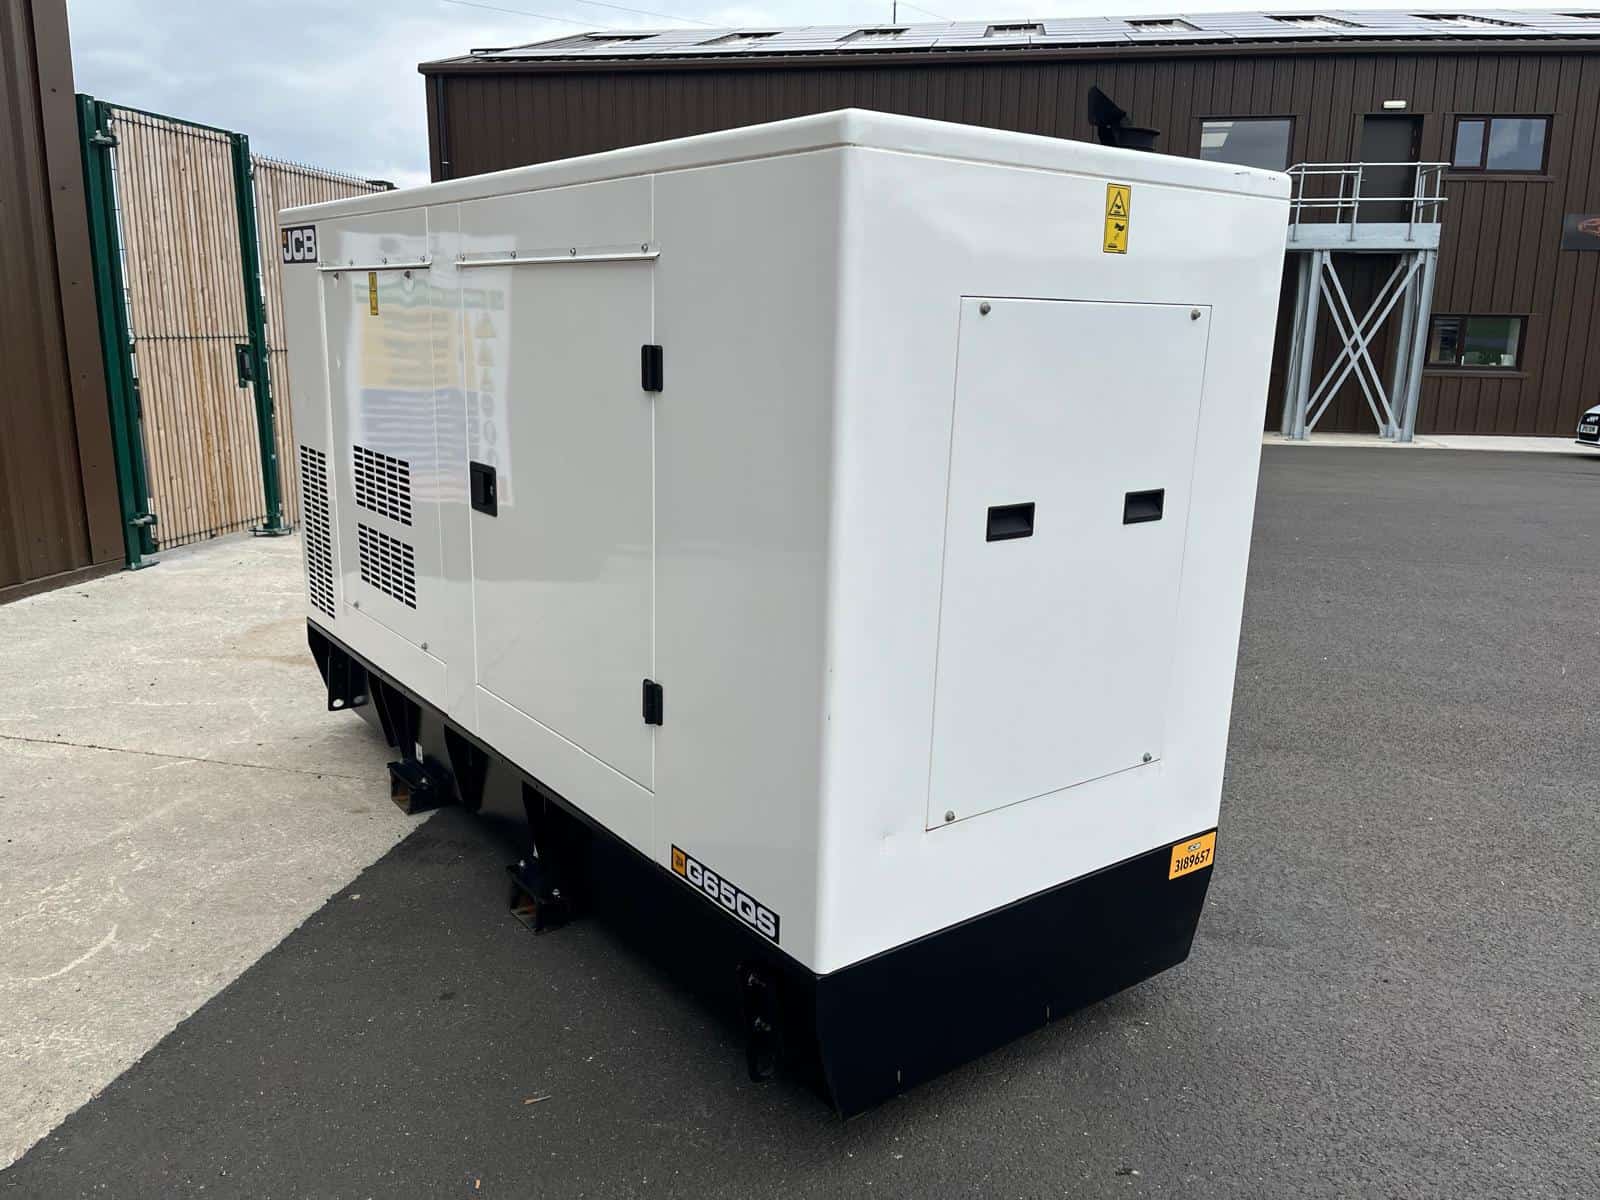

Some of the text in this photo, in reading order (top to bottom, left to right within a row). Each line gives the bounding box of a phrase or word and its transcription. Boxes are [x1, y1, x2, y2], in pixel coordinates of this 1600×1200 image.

[283, 229, 316, 261] JCB
[1174, 848, 1211, 873] 3189657
[686, 858, 776, 938] G65QS
